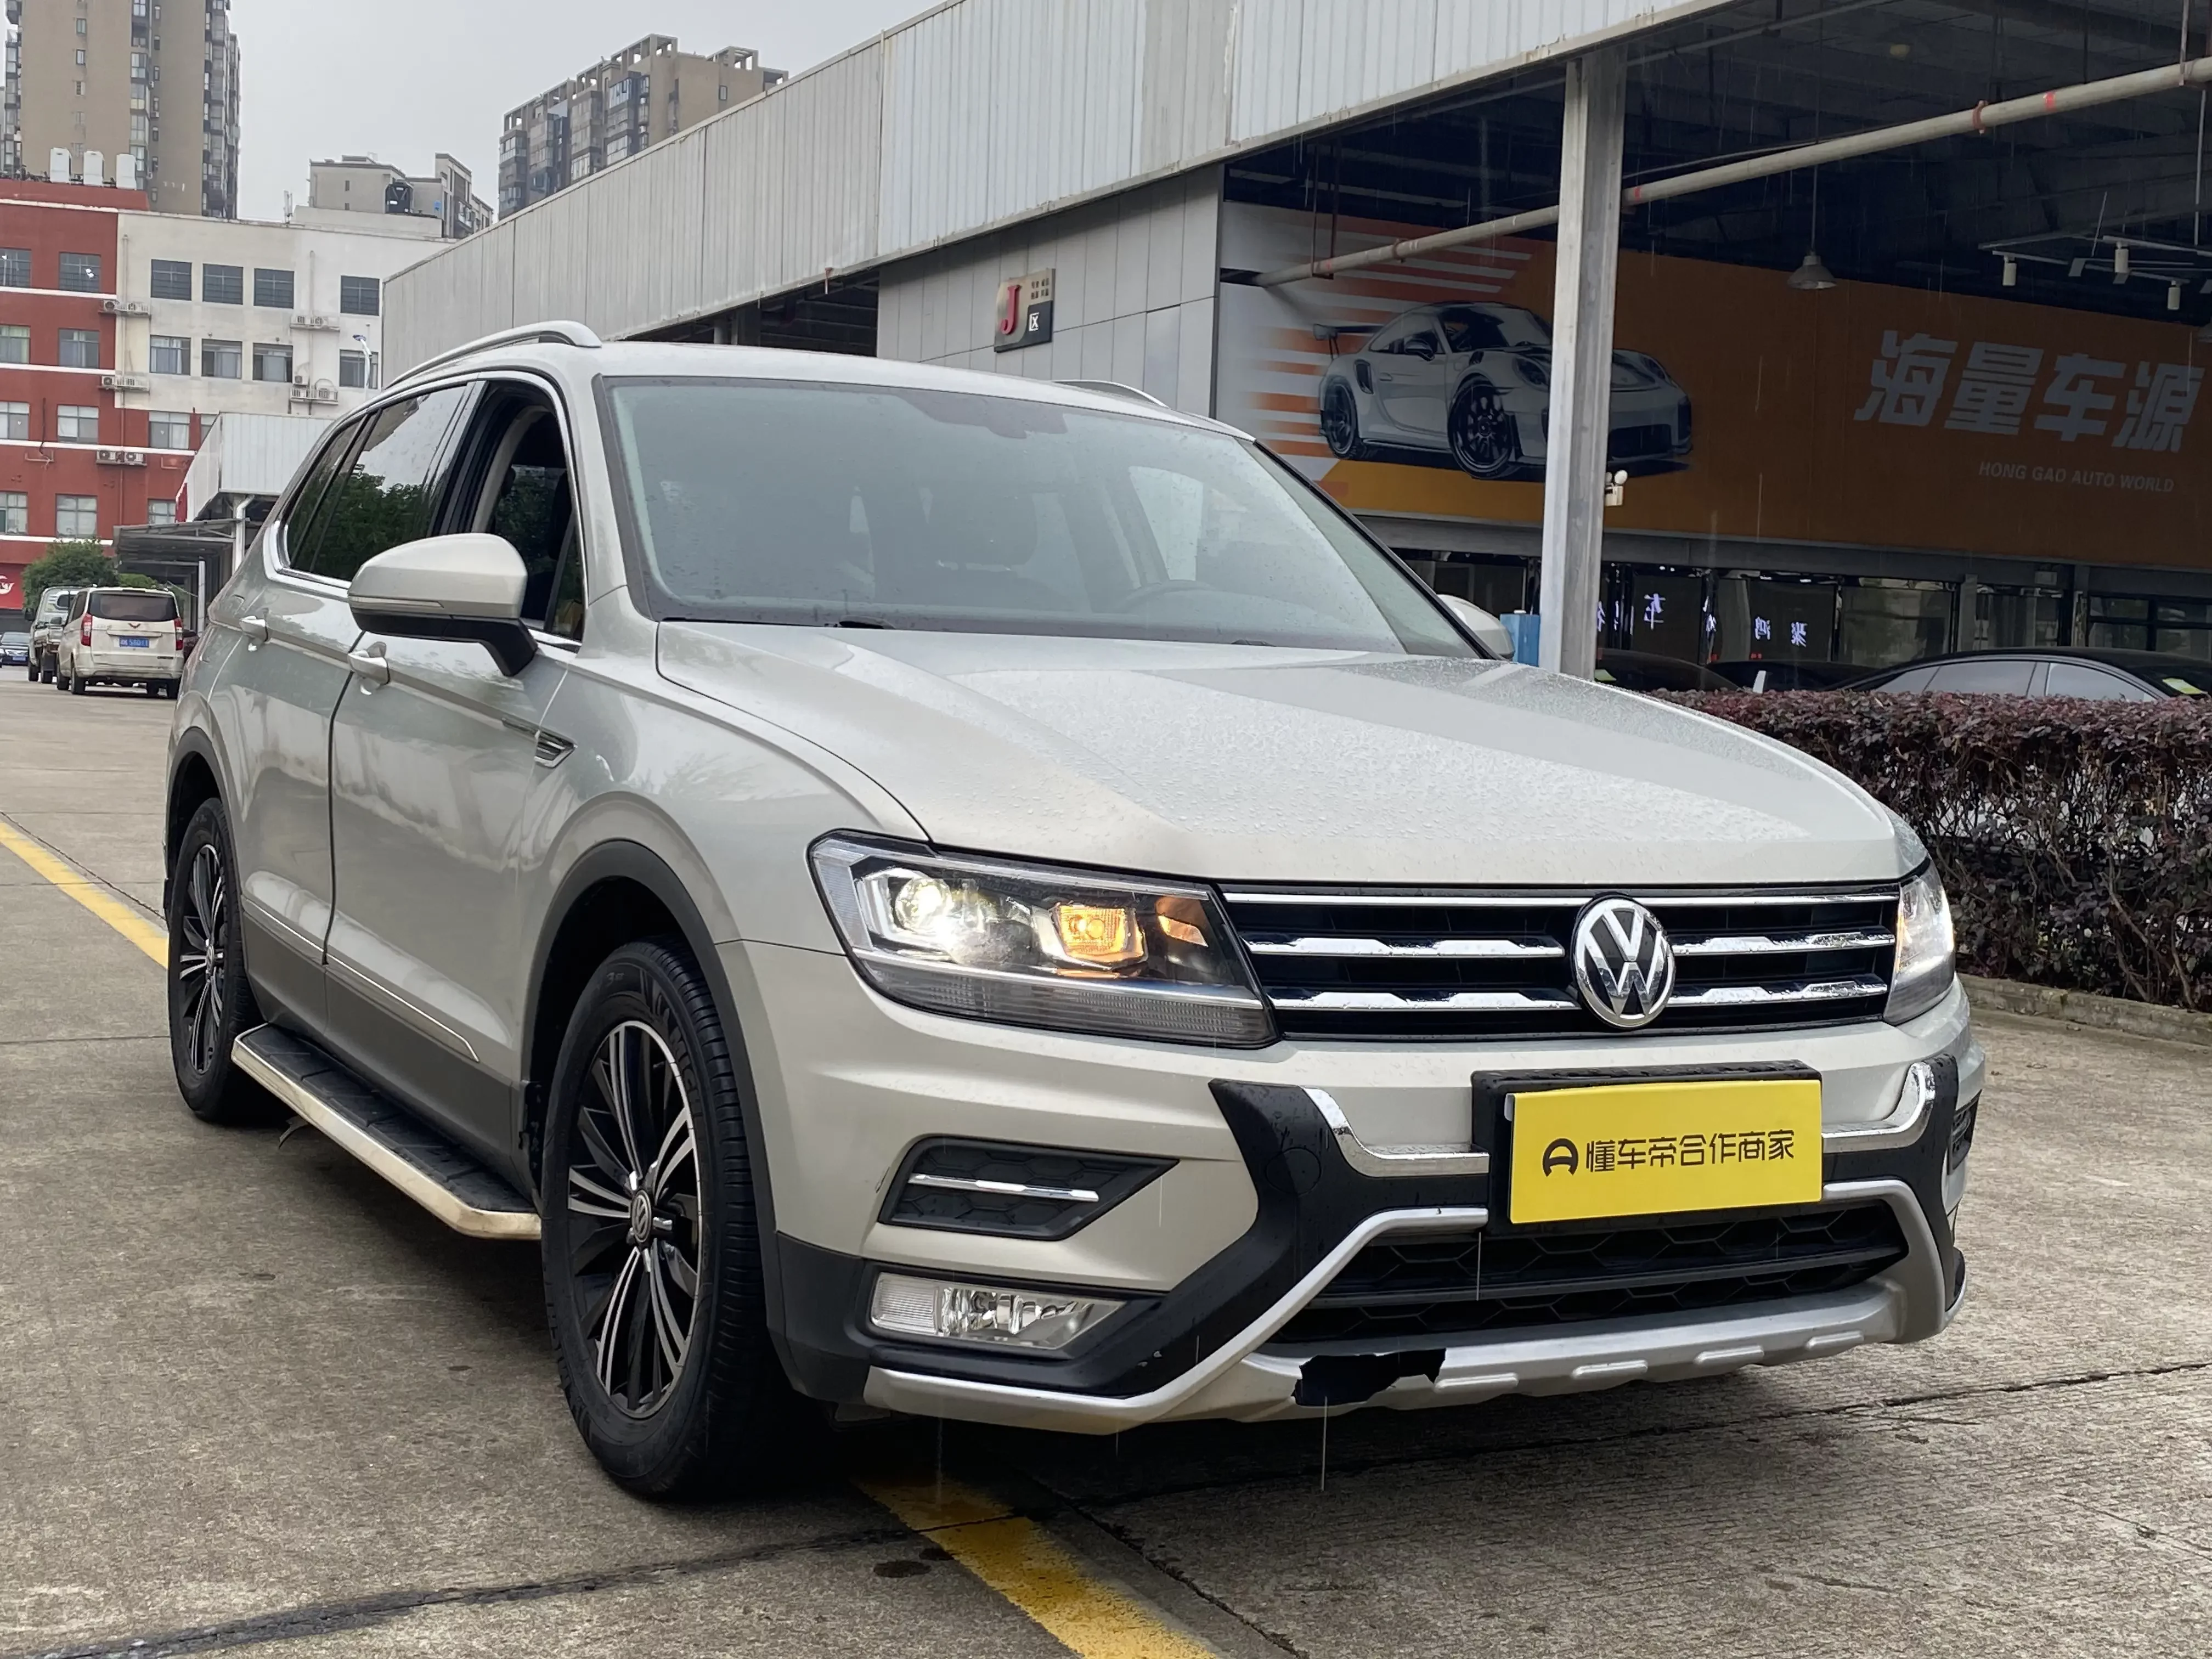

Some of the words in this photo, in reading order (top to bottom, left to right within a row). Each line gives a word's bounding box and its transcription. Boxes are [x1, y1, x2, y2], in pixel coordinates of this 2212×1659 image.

[1001, 285, 1020, 334] J
[1029, 312, 1040, 331] 区
[1853, 330, 2205, 453] 海量车源
[1978, 461, 2027, 479] HONG
[2070, 470, 2114, 488] AUTO
[2119, 473, 2175, 493] WORLD
[1586, 1129, 1795, 1172] 懂车帝合作商家
